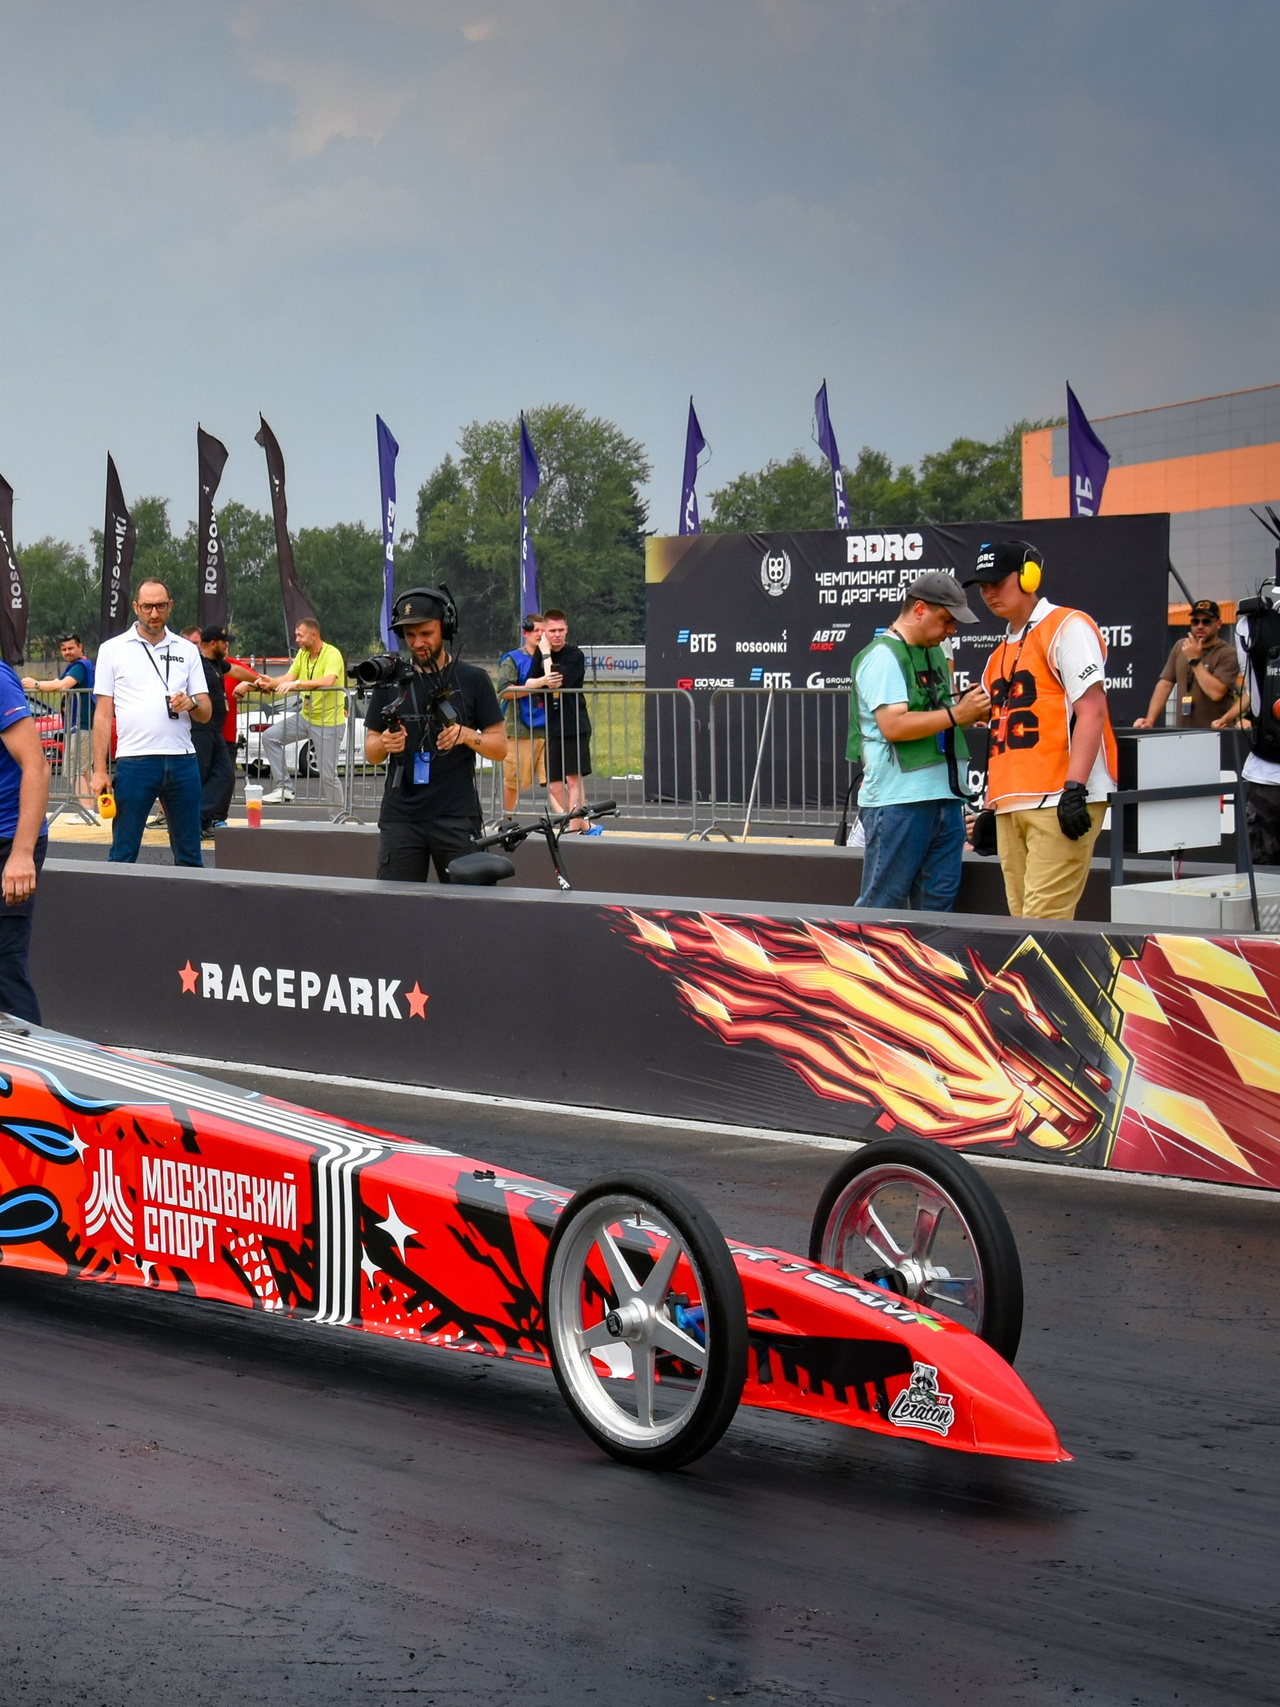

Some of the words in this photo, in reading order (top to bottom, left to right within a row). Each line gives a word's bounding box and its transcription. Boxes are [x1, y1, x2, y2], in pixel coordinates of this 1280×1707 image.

[1075, 474, 1093, 517] ТБ
[846, 533, 923, 563] RDRC
[815, 569, 896, 587] ЧЕМПИОНАТ
[819, 589, 837, 604] ПО
[841, 583, 910, 605] ДРЭГ-РЕЙ
[690, 633, 717, 653] ВТБ
[735, 642, 787, 653] ROSGONKI
[811, 630, 846, 642] АВТО
[764, 673, 791, 689] ВТБ
[200, 961, 403, 1020] RACEPARK
[142, 1155, 298, 1231] МОСКОВСКИЙ
[143, 1205, 217, 1263] СПОРТ
[780, 1262, 926, 1322] TEAM
